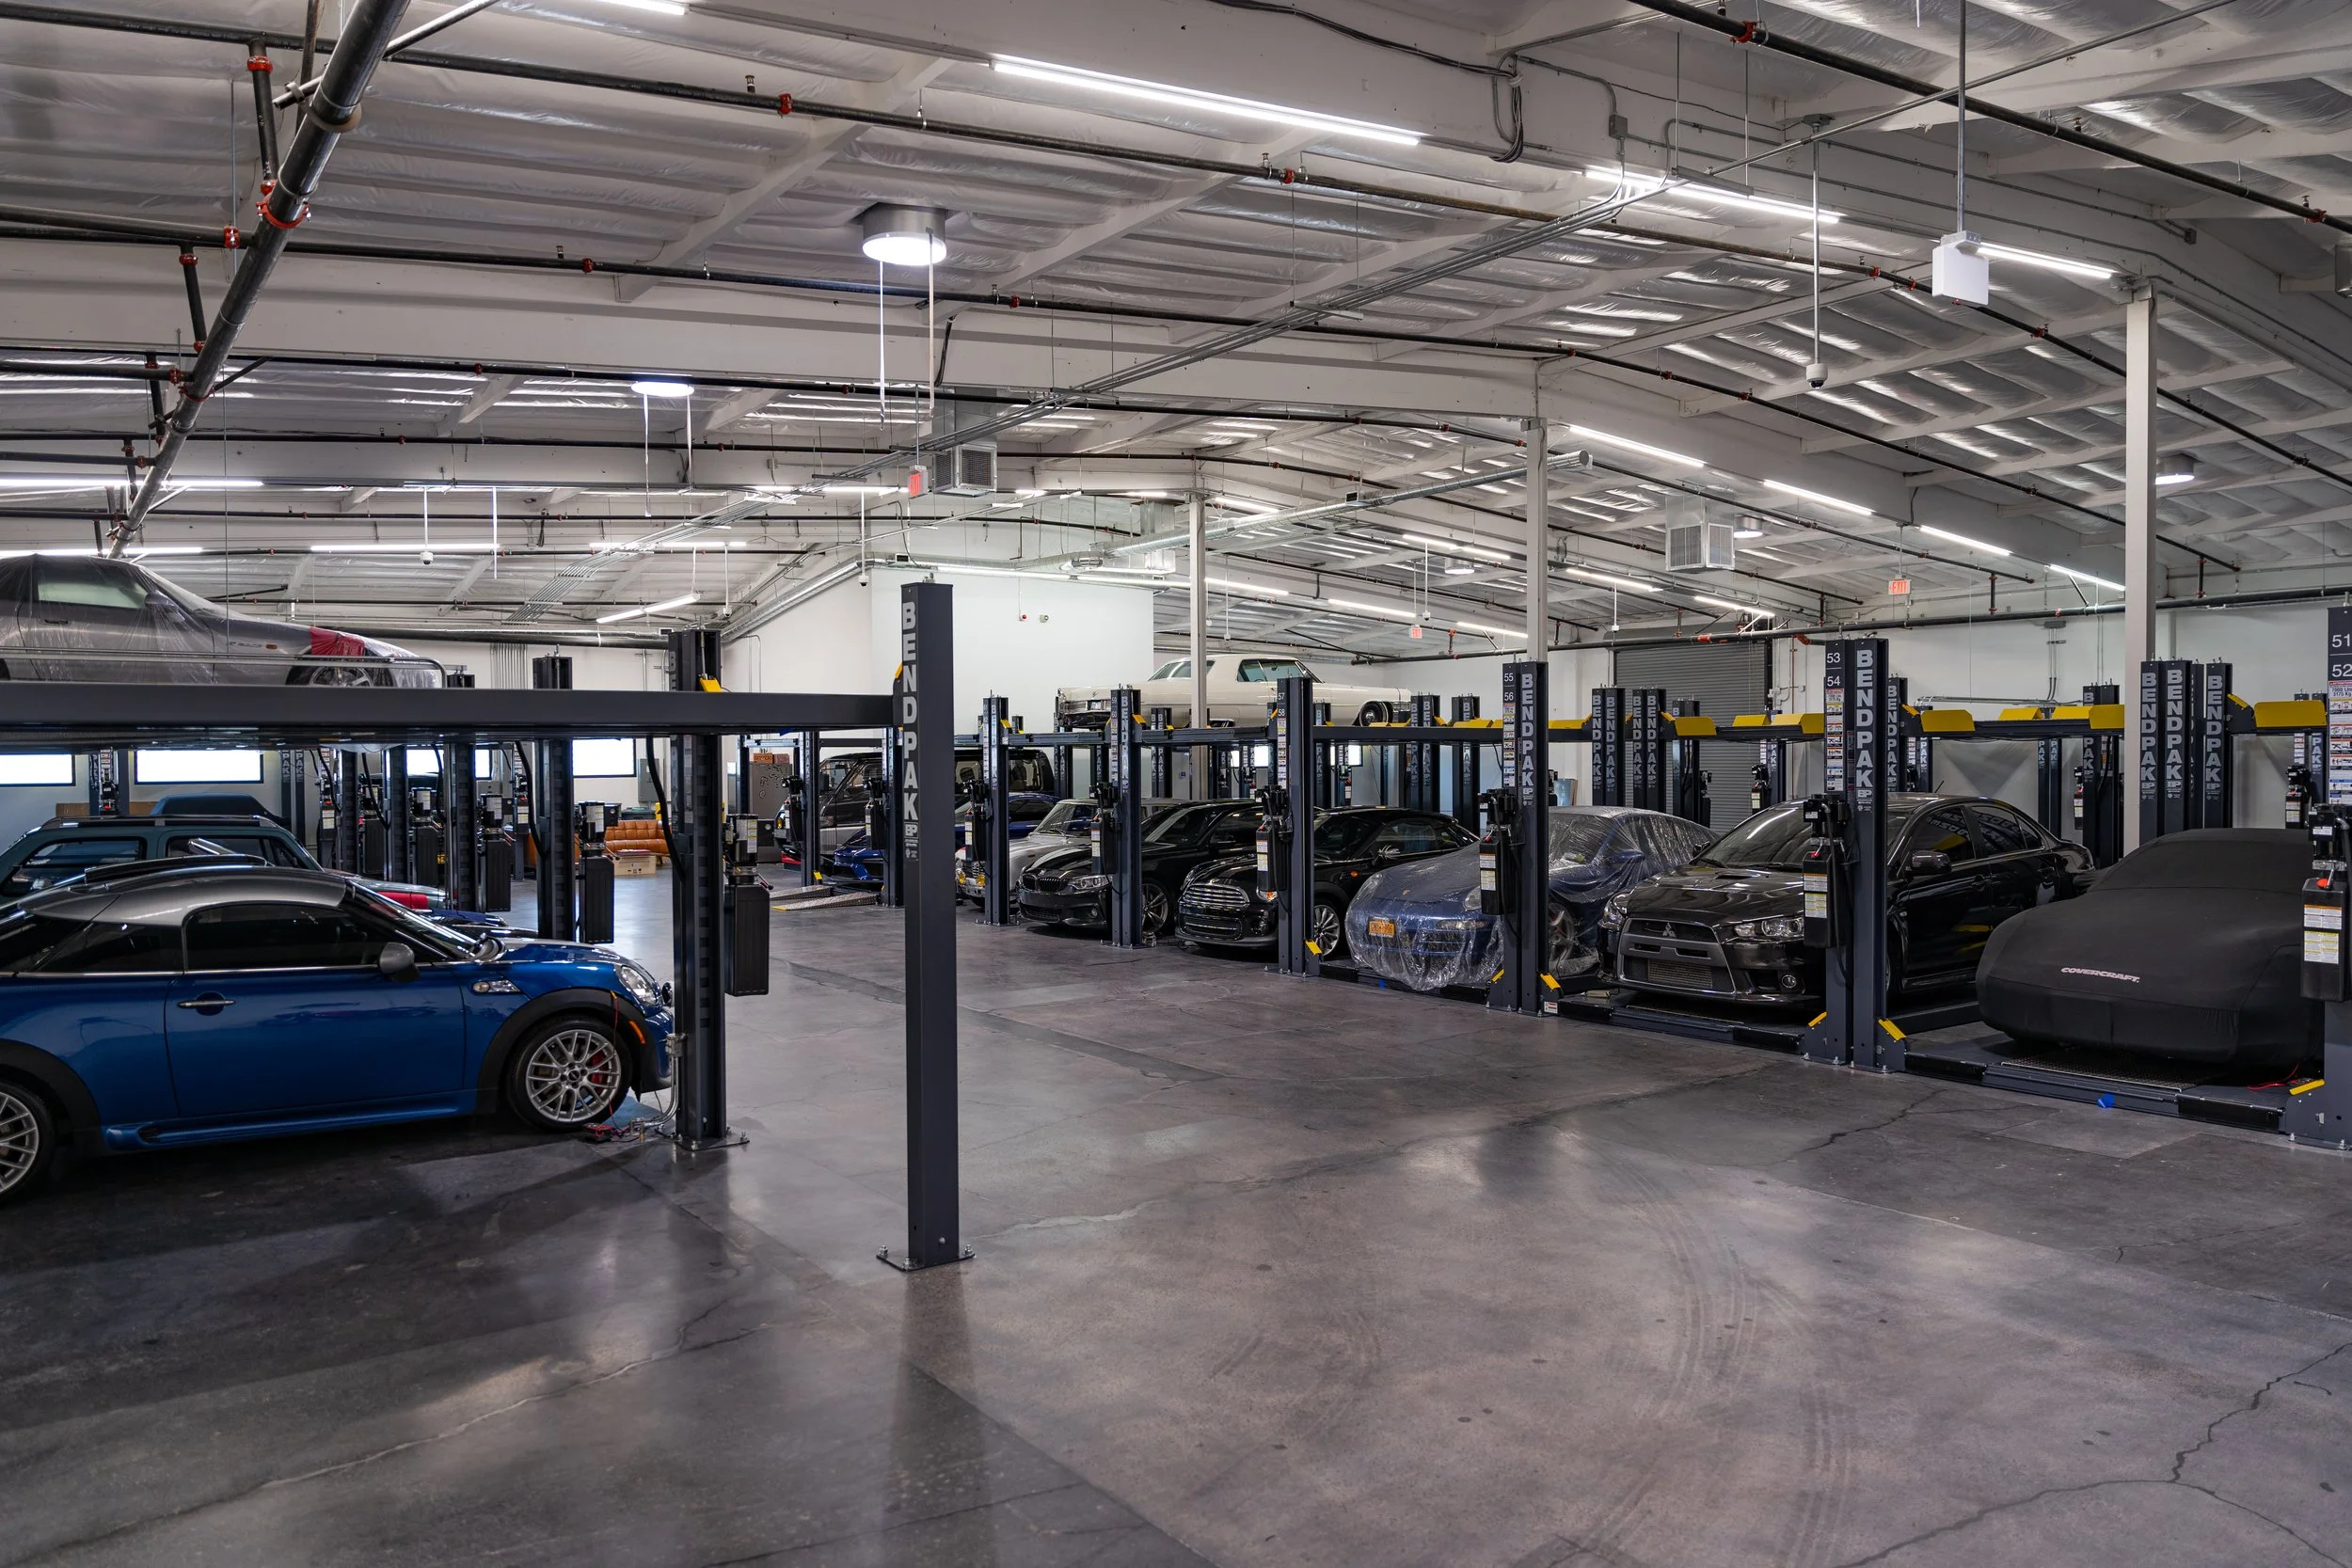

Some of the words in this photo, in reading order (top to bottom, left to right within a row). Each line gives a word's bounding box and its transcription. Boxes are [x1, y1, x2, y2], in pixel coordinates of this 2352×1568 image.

[1892, 580, 1908, 594] EXIT
[1503, 673, 1514, 682] 55
[1826, 652, 1840, 663] 53
[2331, 633, 2350, 648] 51
[2331, 663, 2352, 677] 52
[902, 601, 918, 820] BENDPAK
[1278, 708, 1285, 717] 58
[1503, 691, 1514, 701] 56
[1827, 676, 1840, 687] 54
[1856, 649, 1873, 787] BENDPAK
[1521, 673, 1534, 786] BENDPAK
[1592, 695, 1602, 776] BENDPAK
[1606, 697, 1615, 778] BENDPAK
[1633, 696, 1642, 775] BENDPAK
[1647, 695, 1657, 775] BENDPAK
[1887, 685, 1898, 776] BENDPAK
[2141, 673, 2156, 781] BENDPAK
[2166, 669, 2183, 780] BENDPAK
[2205, 675, 2222, 782] BENDPAK
[905, 824, 917, 836] BP
